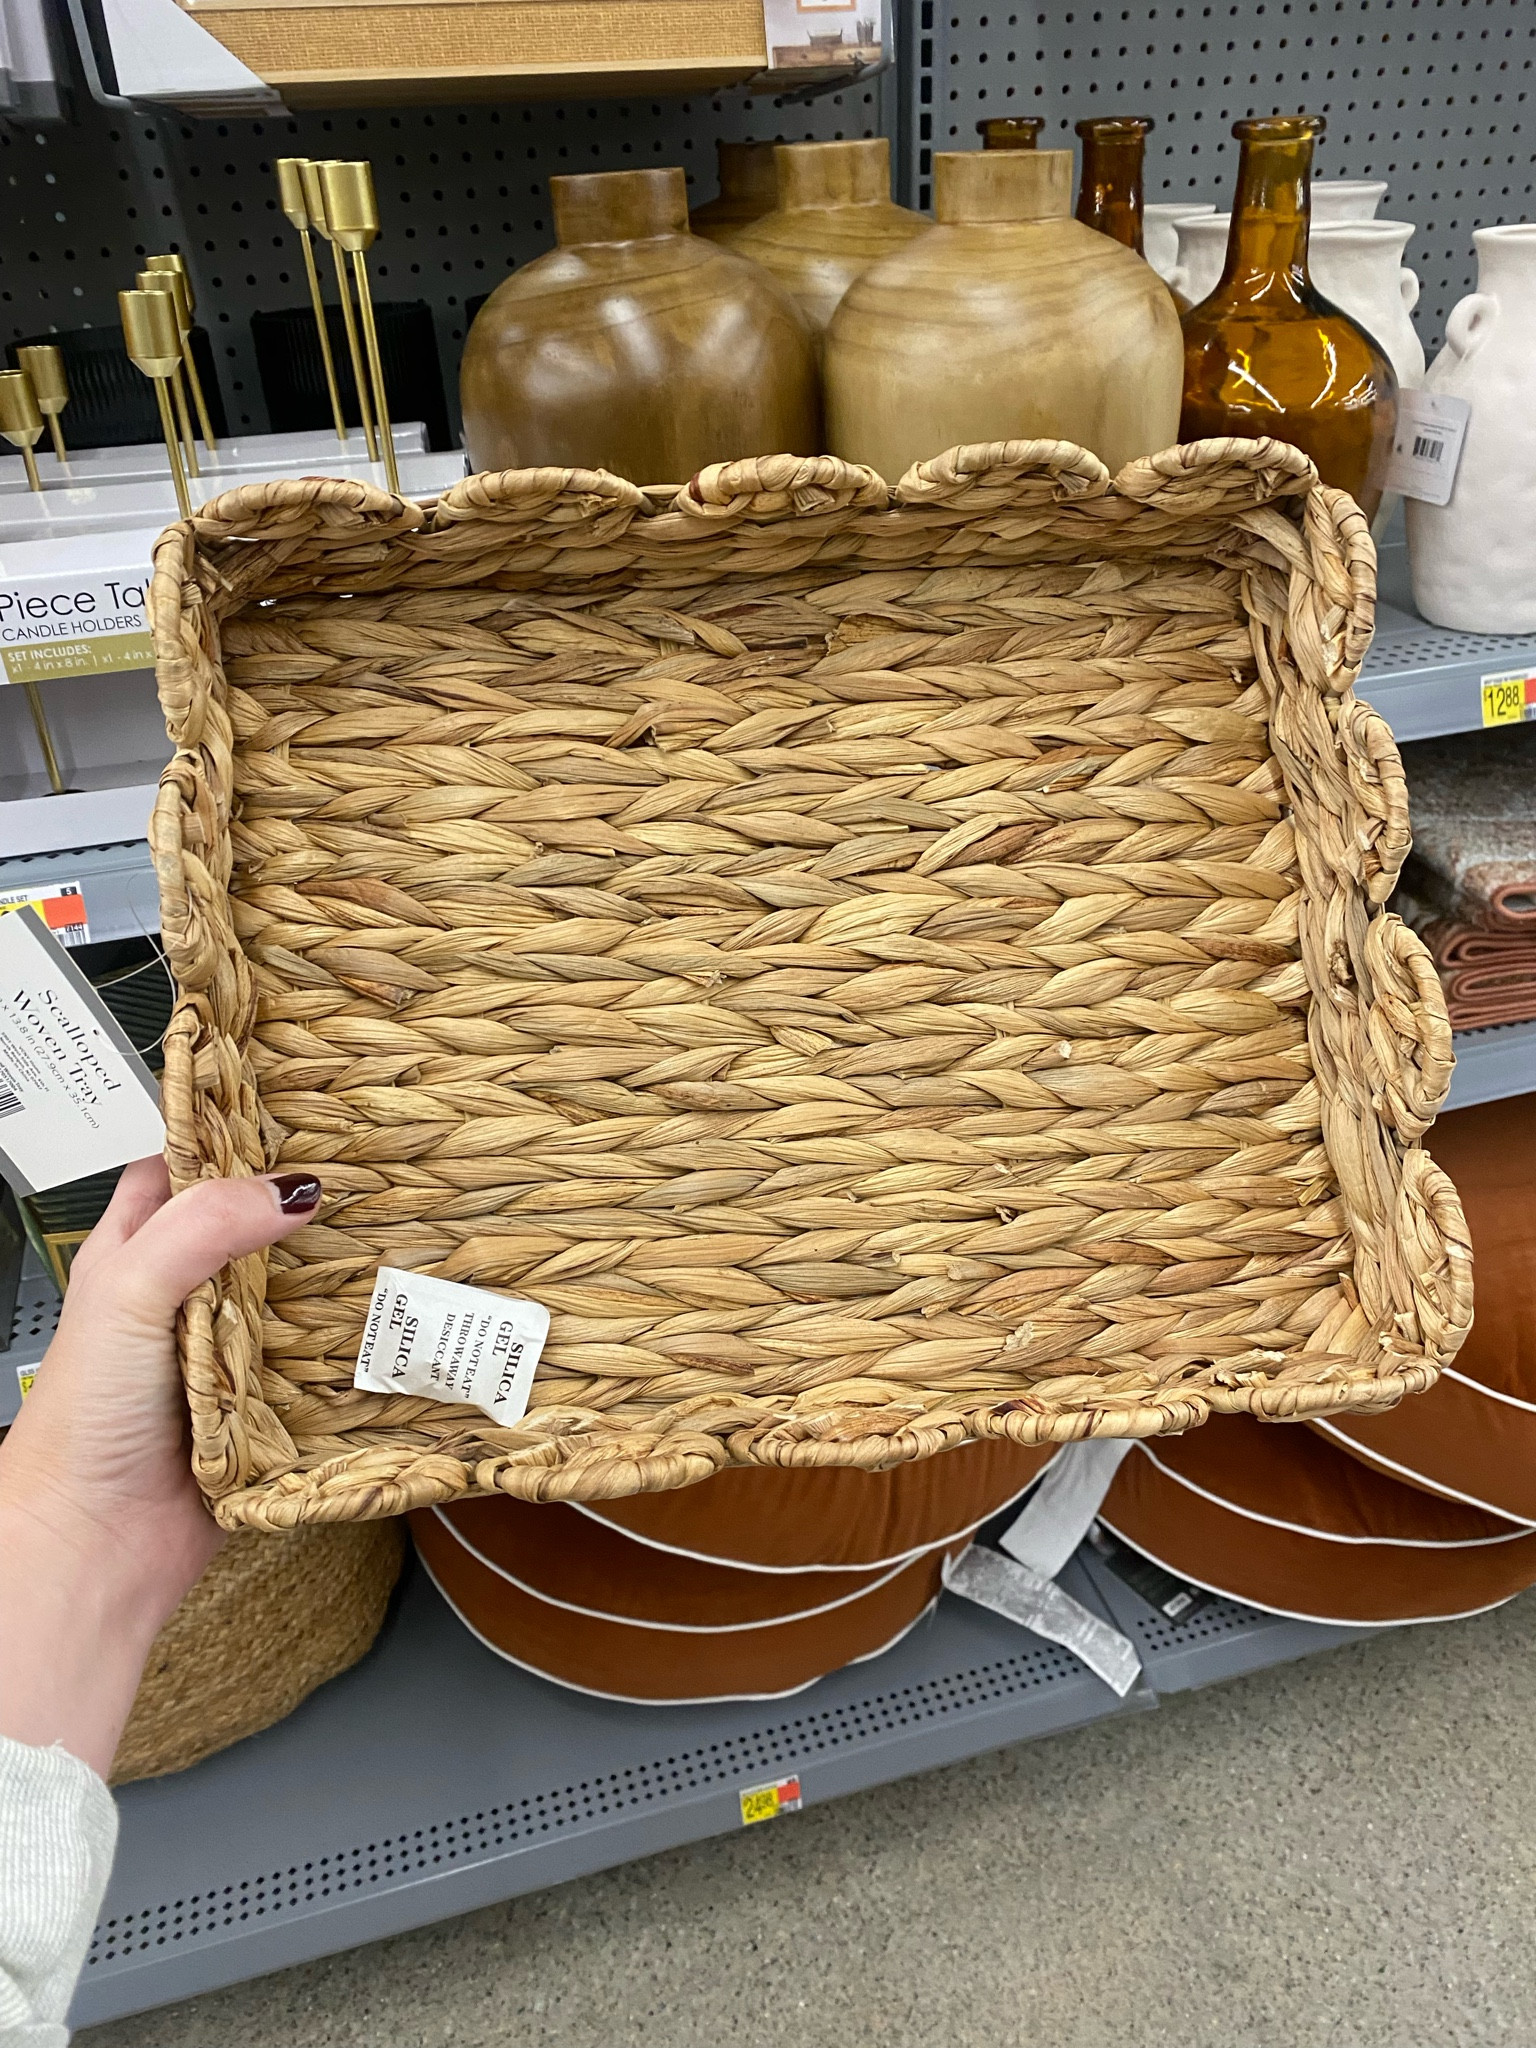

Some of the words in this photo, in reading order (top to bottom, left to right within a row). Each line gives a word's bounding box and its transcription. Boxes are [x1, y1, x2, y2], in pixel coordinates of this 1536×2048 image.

[0, 592, 96, 621] Piece
[104, 578, 150, 609] Ta
[2, 623, 68, 641] CANDLE
[72, 614, 142, 634] HOLDERS
[8, 651, 28, 662] SET
[30, 644, 92, 660] INCLUDES:
[66, 657, 73, 667] 8
[14, 990, 66, 1060] Woven
[69, 1062, 101, 1104] Tray
[38, 990, 121, 1090] Scalloped
[10, 1013, 28, 1033] 13.8
[26, 1035, 35, 1044] in
[34, 1046, 64, 1083] (27.9cm
[69, 1092, 99, 1128] 35.1cm)
[368, 1314, 381, 1340] NOT
[390, 1294, 407, 1329] GEL
[392, 1316, 418, 1378] SILICA
[431, 1314, 455, 1381] DESICCANT
[469, 1340, 484, 1366] NOT
[492, 1321, 513, 1355] GEL
[494, 1343, 523, 1404] SILICA
